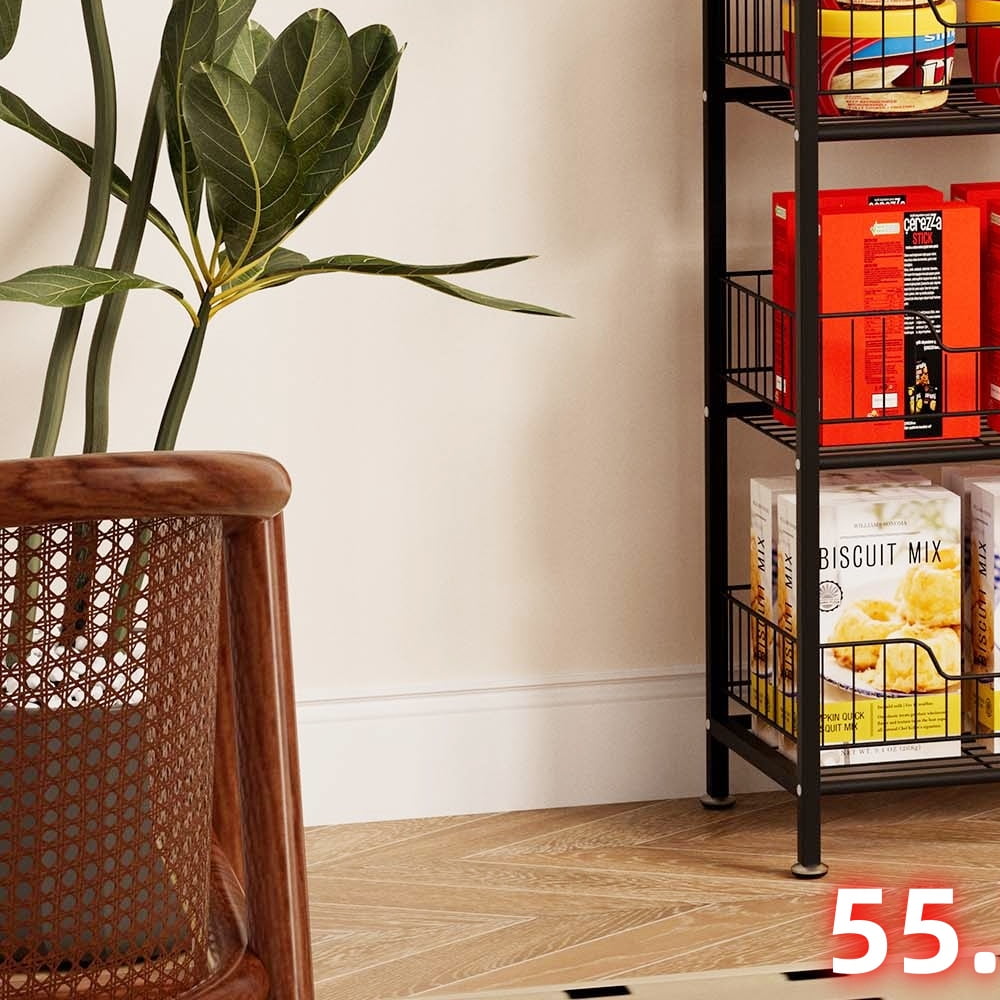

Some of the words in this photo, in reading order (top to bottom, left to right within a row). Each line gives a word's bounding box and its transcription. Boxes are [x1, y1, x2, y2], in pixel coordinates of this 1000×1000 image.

[913, 232, 932, 244] STICK
[757, 536, 766, 571] MIX
[819, 542, 896, 570] BISCUIT
[908, 540, 941, 564] MIX
[978, 542, 987, 576] MIX
[784, 553, 793, 589] MIX
